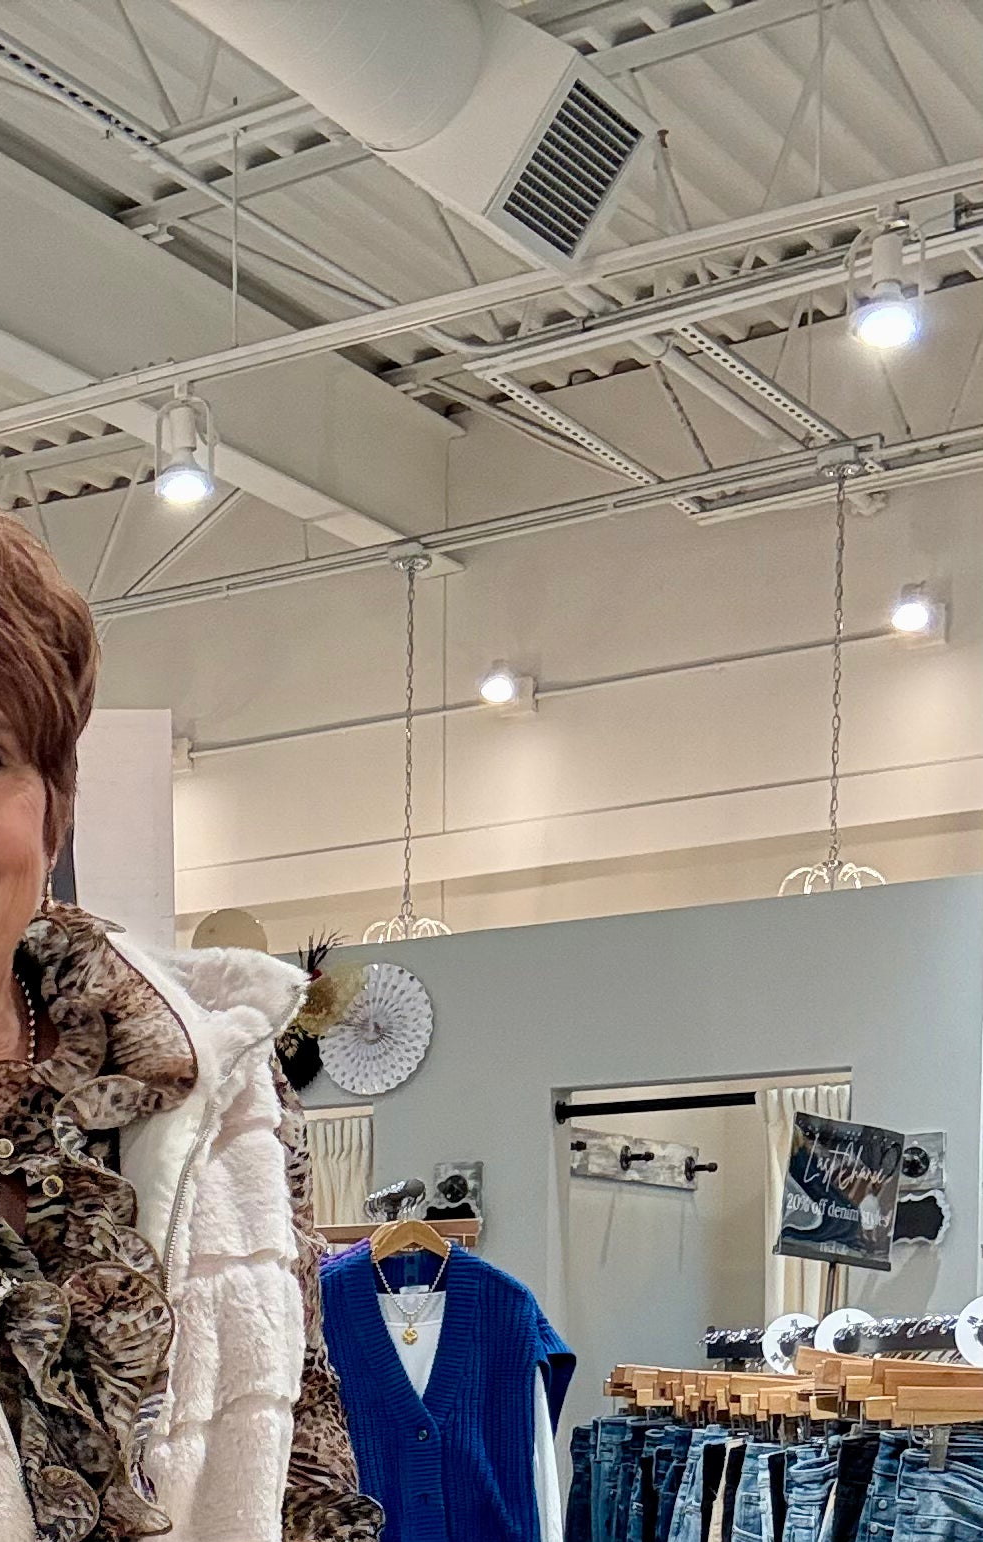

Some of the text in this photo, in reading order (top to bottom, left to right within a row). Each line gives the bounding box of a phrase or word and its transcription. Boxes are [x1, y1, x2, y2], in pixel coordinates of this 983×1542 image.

[803, 1132, 849, 1192] Last
[786, 1192, 810, 1213] 20%
[811, 1198, 829, 1217] off
[827, 1200, 859, 1221] denim
